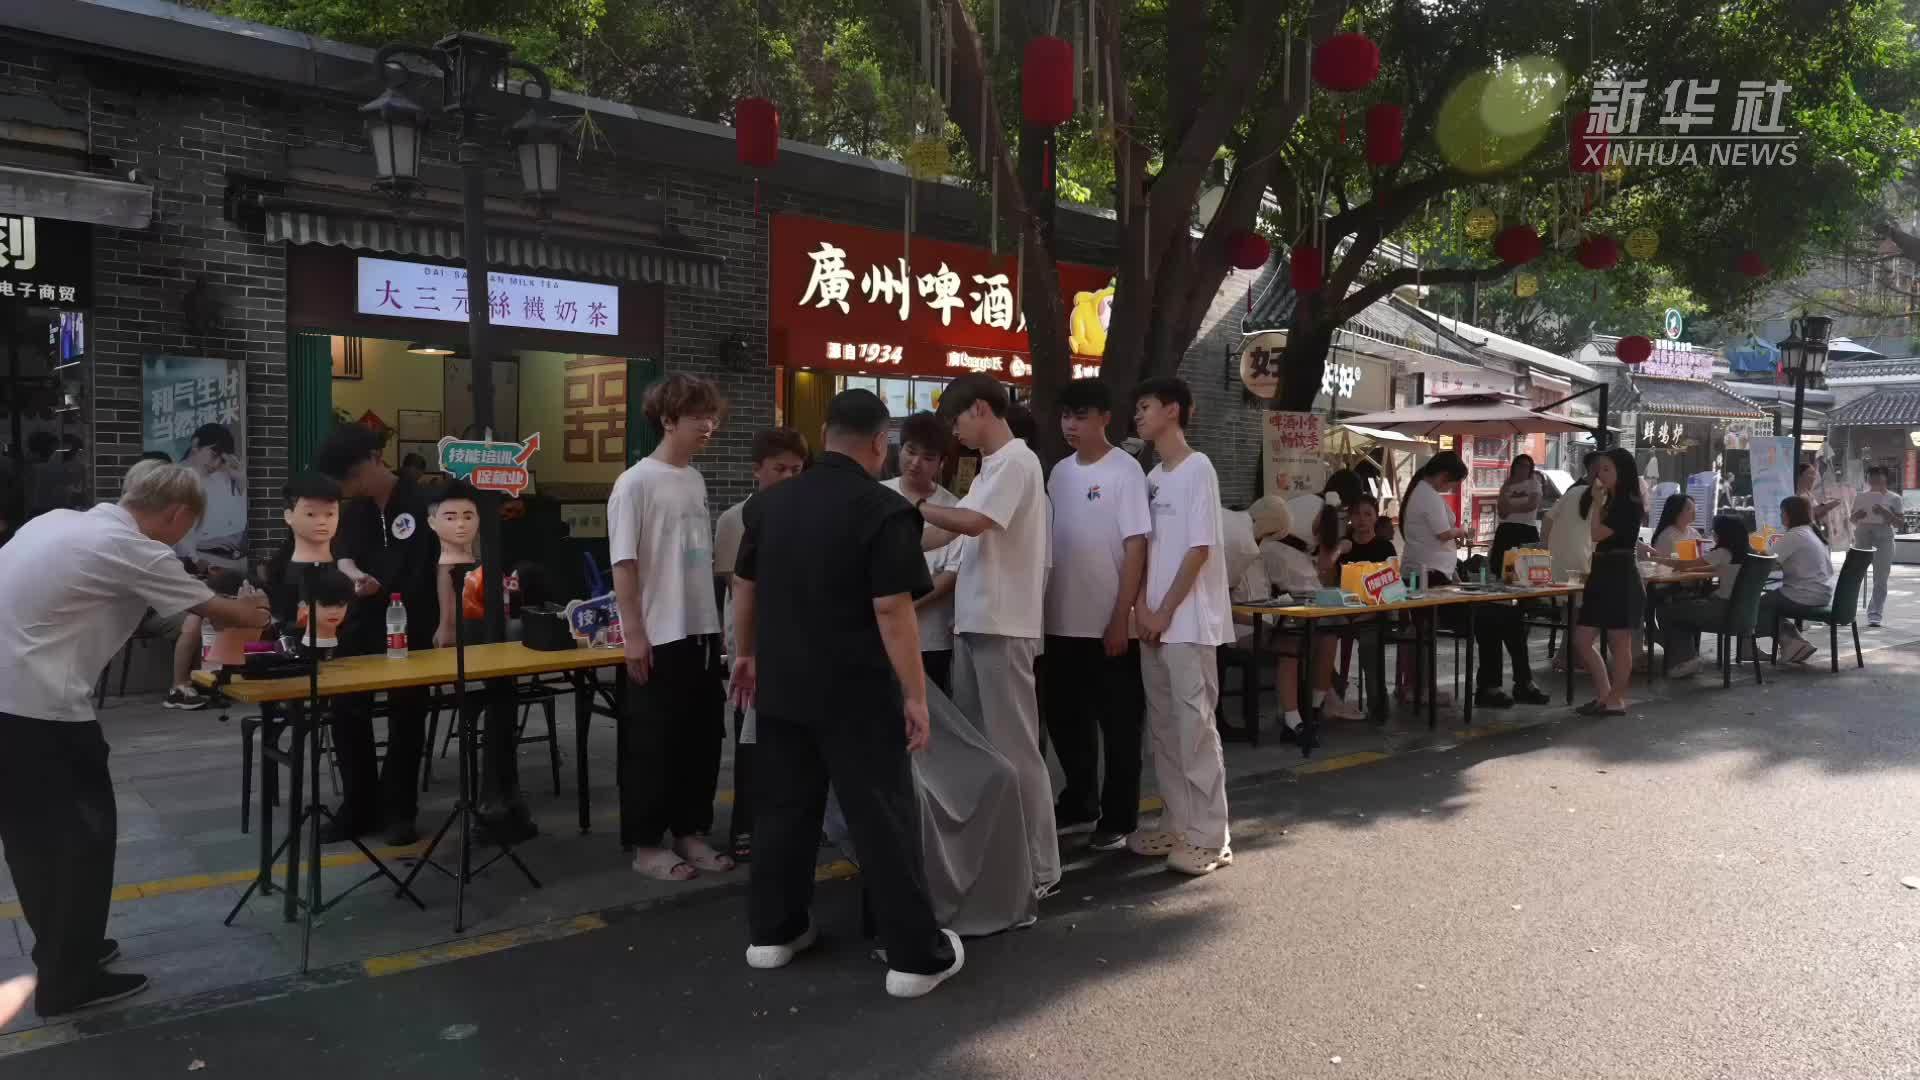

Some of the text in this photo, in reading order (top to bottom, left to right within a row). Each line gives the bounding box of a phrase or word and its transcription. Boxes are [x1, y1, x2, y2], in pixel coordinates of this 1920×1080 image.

[0, 280, 76, 303] 电子商贸
[541, 280, 559, 289] TEA
[798, 241, 1027, 333] 廣州啤酒
[151, 369, 240, 416] 和气生财
[448, 447, 512, 465] 技能培训
